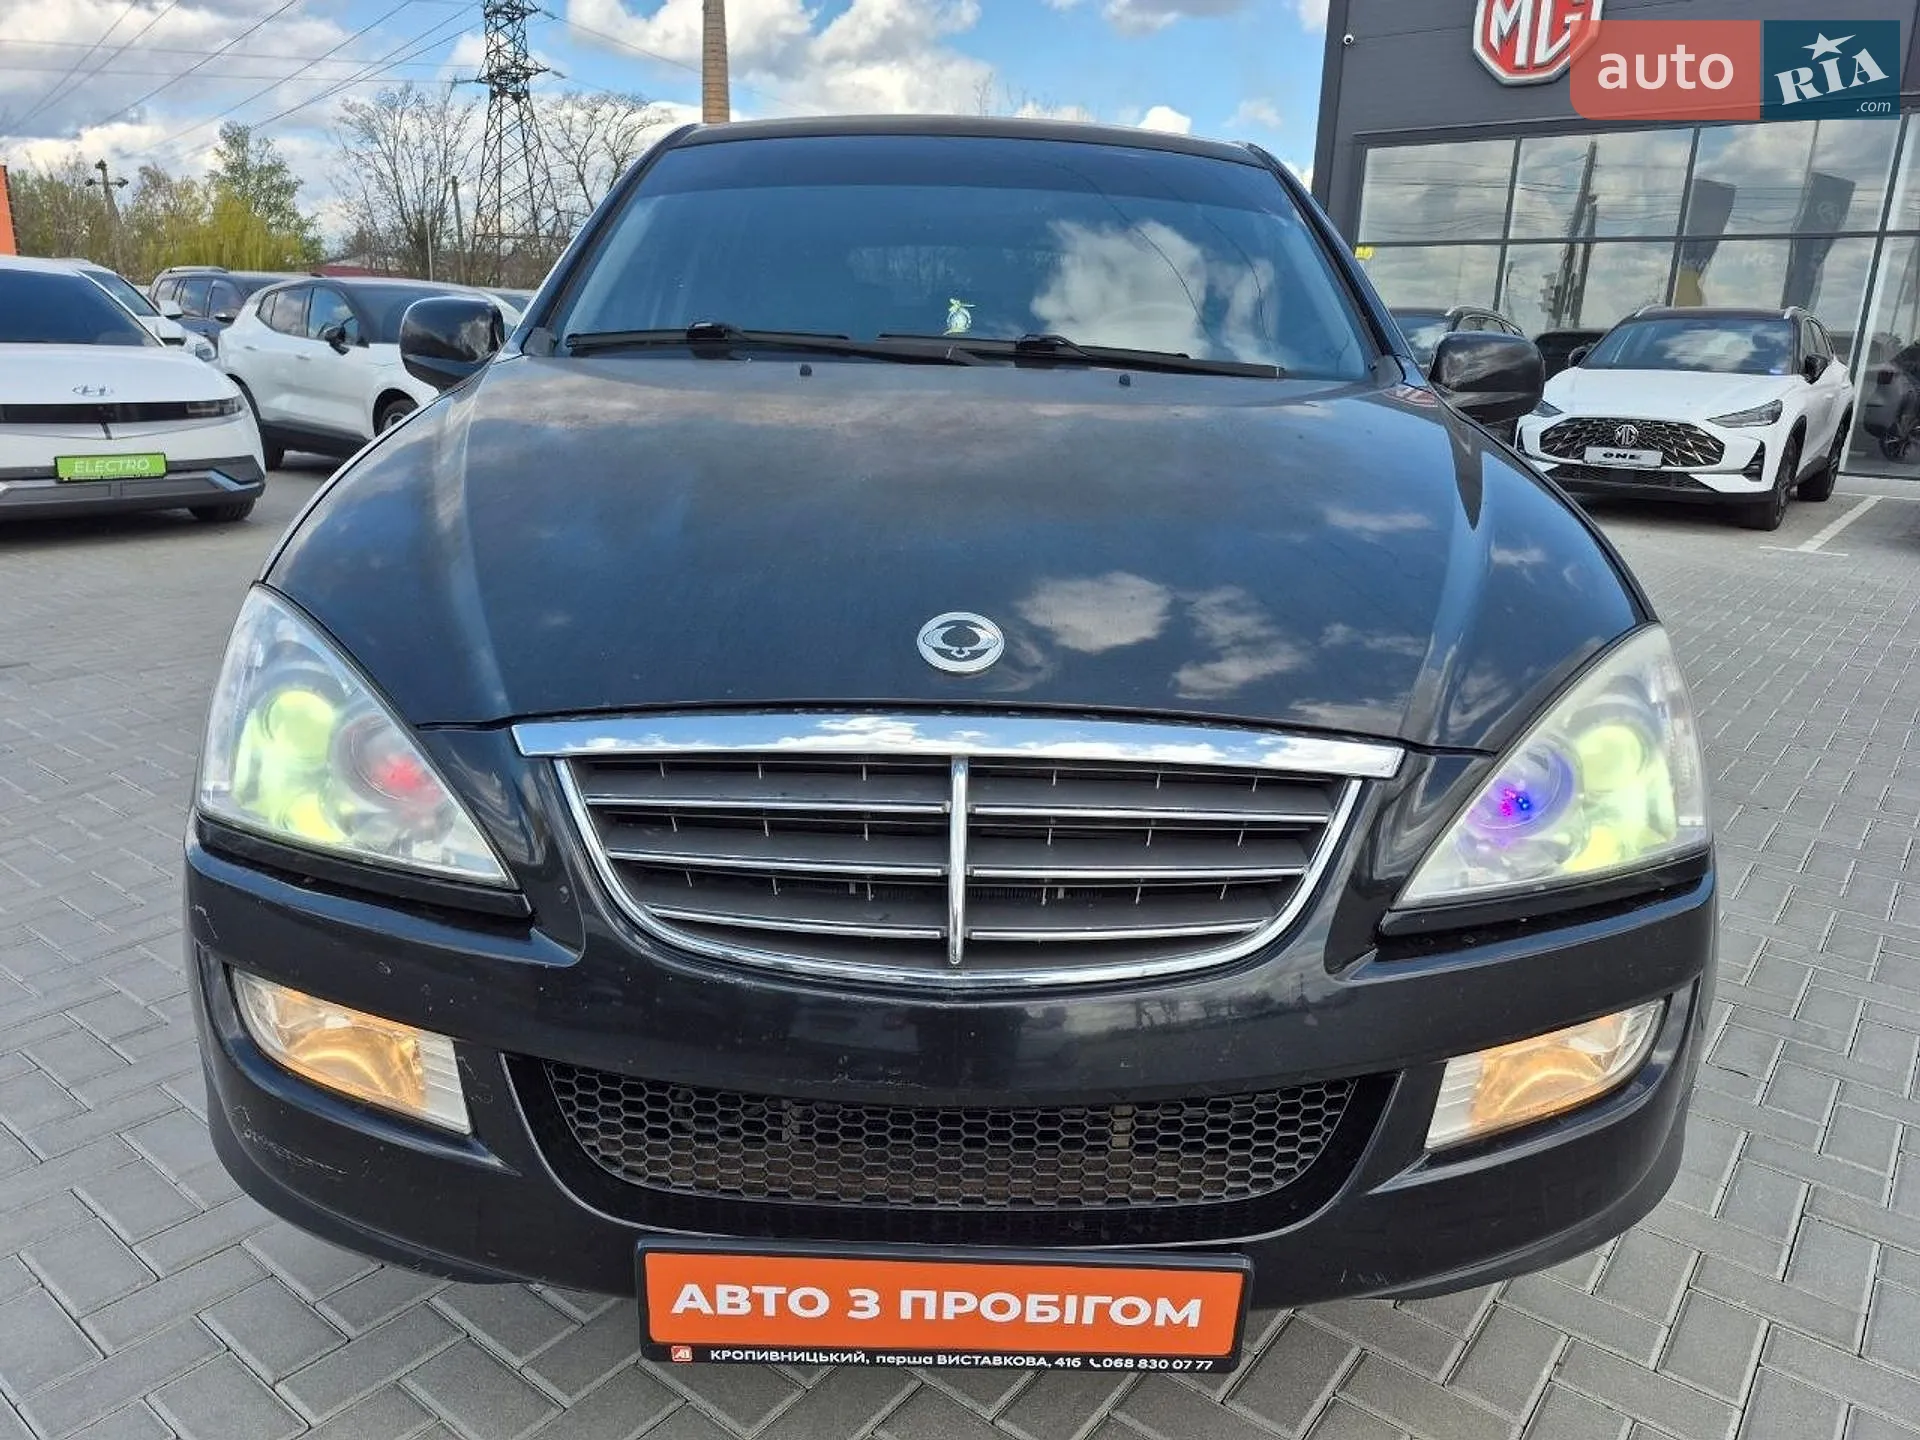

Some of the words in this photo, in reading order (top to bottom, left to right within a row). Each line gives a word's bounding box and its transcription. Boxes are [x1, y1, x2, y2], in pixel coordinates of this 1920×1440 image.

[1489, 0, 1583, 66] MG
[1615, 425, 1637, 446] MG
[74, 458, 150, 474] ELECTRO
[1602, 452, 1641, 460] ONE
[671, 1283, 830, 1318] АВТО
[899, 1289, 1201, 1328] ПРОБІГОМ
[710, 1349, 870, 1365] КРОПИВНИЦЬКИЙ,
[876, 1355, 932, 1366] перша
[938, 1355, 1052, 1368] ВИСТАВКОВА,
[1103, 1357, 1134, 1368] 068
[1137, 1358, 1169, 1370] 830
[1172, 1359, 1192, 1370] 07
[1195, 1360, 1213, 1371] 77
